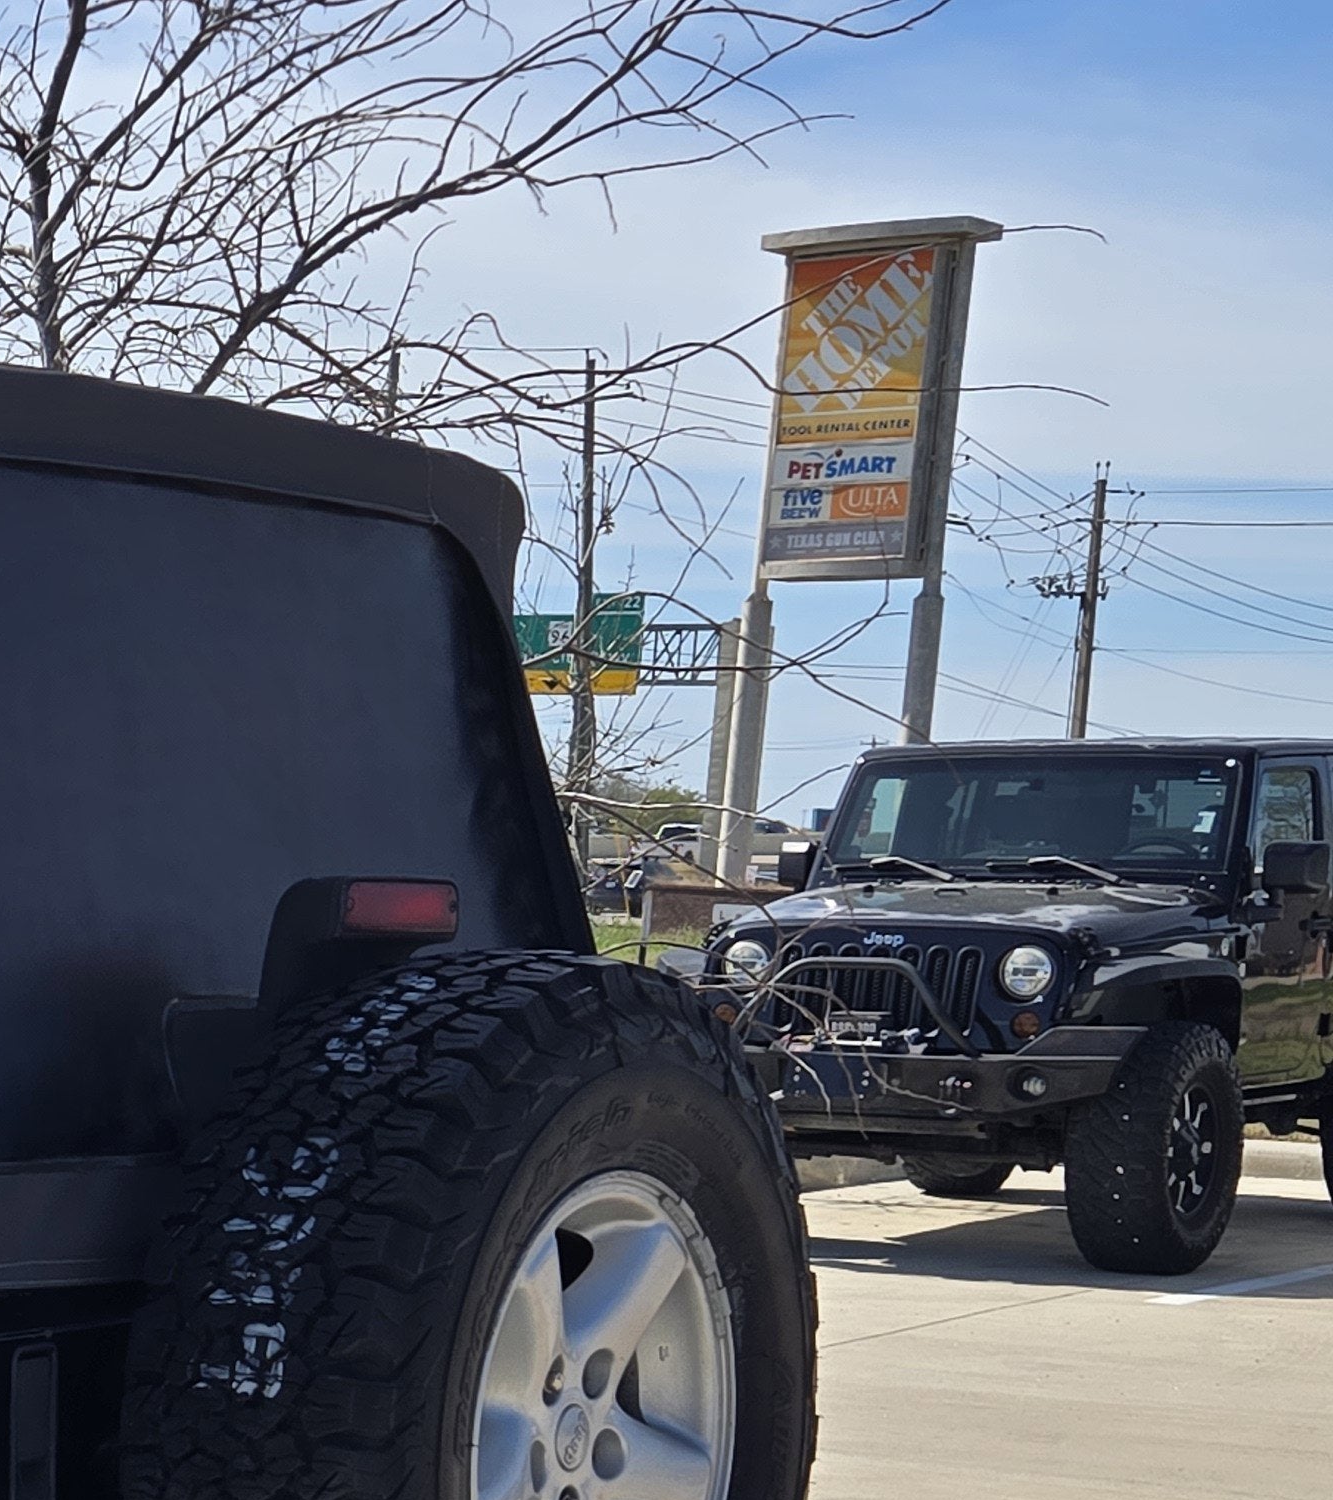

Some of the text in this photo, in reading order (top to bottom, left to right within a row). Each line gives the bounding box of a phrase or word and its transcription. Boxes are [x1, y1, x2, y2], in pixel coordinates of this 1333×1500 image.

[800, 274, 863, 338] THE
[783, 252, 933, 413] HOME
[837, 309, 930, 410] DEPOT
[783, 419, 910, 436] TOOL RENTAL CENTER
[783, 487, 823, 506] five
[848, 486, 899, 508] ULTA
[786, 532, 823, 548] TEXAS
[825, 532, 852, 547] GUN
[623, 595, 641, 609] 22
[551, 629, 571, 643] 96
[862, 931, 905, 948] Jeep
